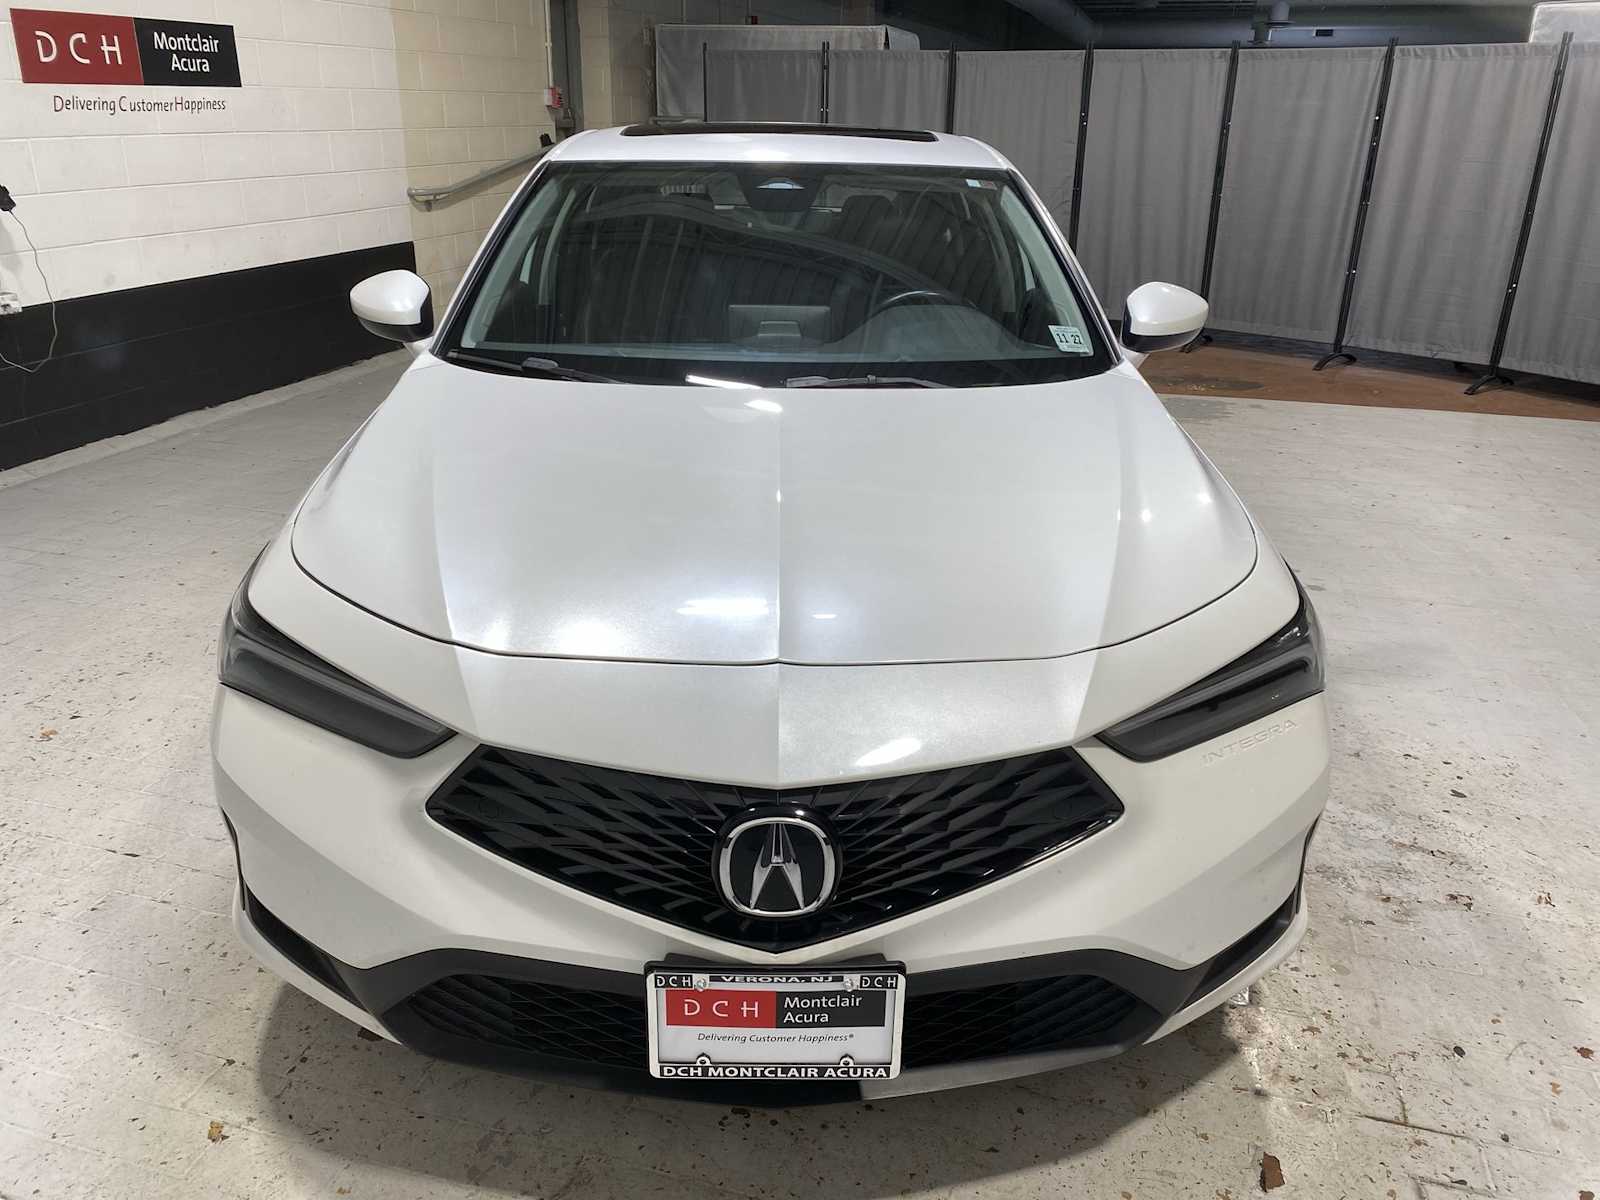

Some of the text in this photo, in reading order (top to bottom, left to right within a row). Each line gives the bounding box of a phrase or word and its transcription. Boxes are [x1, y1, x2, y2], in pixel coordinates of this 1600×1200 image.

[34, 30, 123, 65] DCH
[153, 31, 219, 53] Montclair
[171, 54, 210, 73] Acura
[53, 95, 226, 115] Delivering Customer Happiness
[1201, 719, 1297, 765] INTEGRA
[656, 975, 692, 988] DCH
[721, 976, 806, 984] VERONA,
[861, 975, 897, 988] DCH
[684, 999, 759, 1018] DCH
[783, 995, 862, 1009] Montclair
[783, 1011, 829, 1024] Acura
[697, 1033, 747, 1044] Delivering
[749, 1033, 796, 1043] Customer
[663, 1066, 887, 1078] DCH MONTCLAIR ACURA
